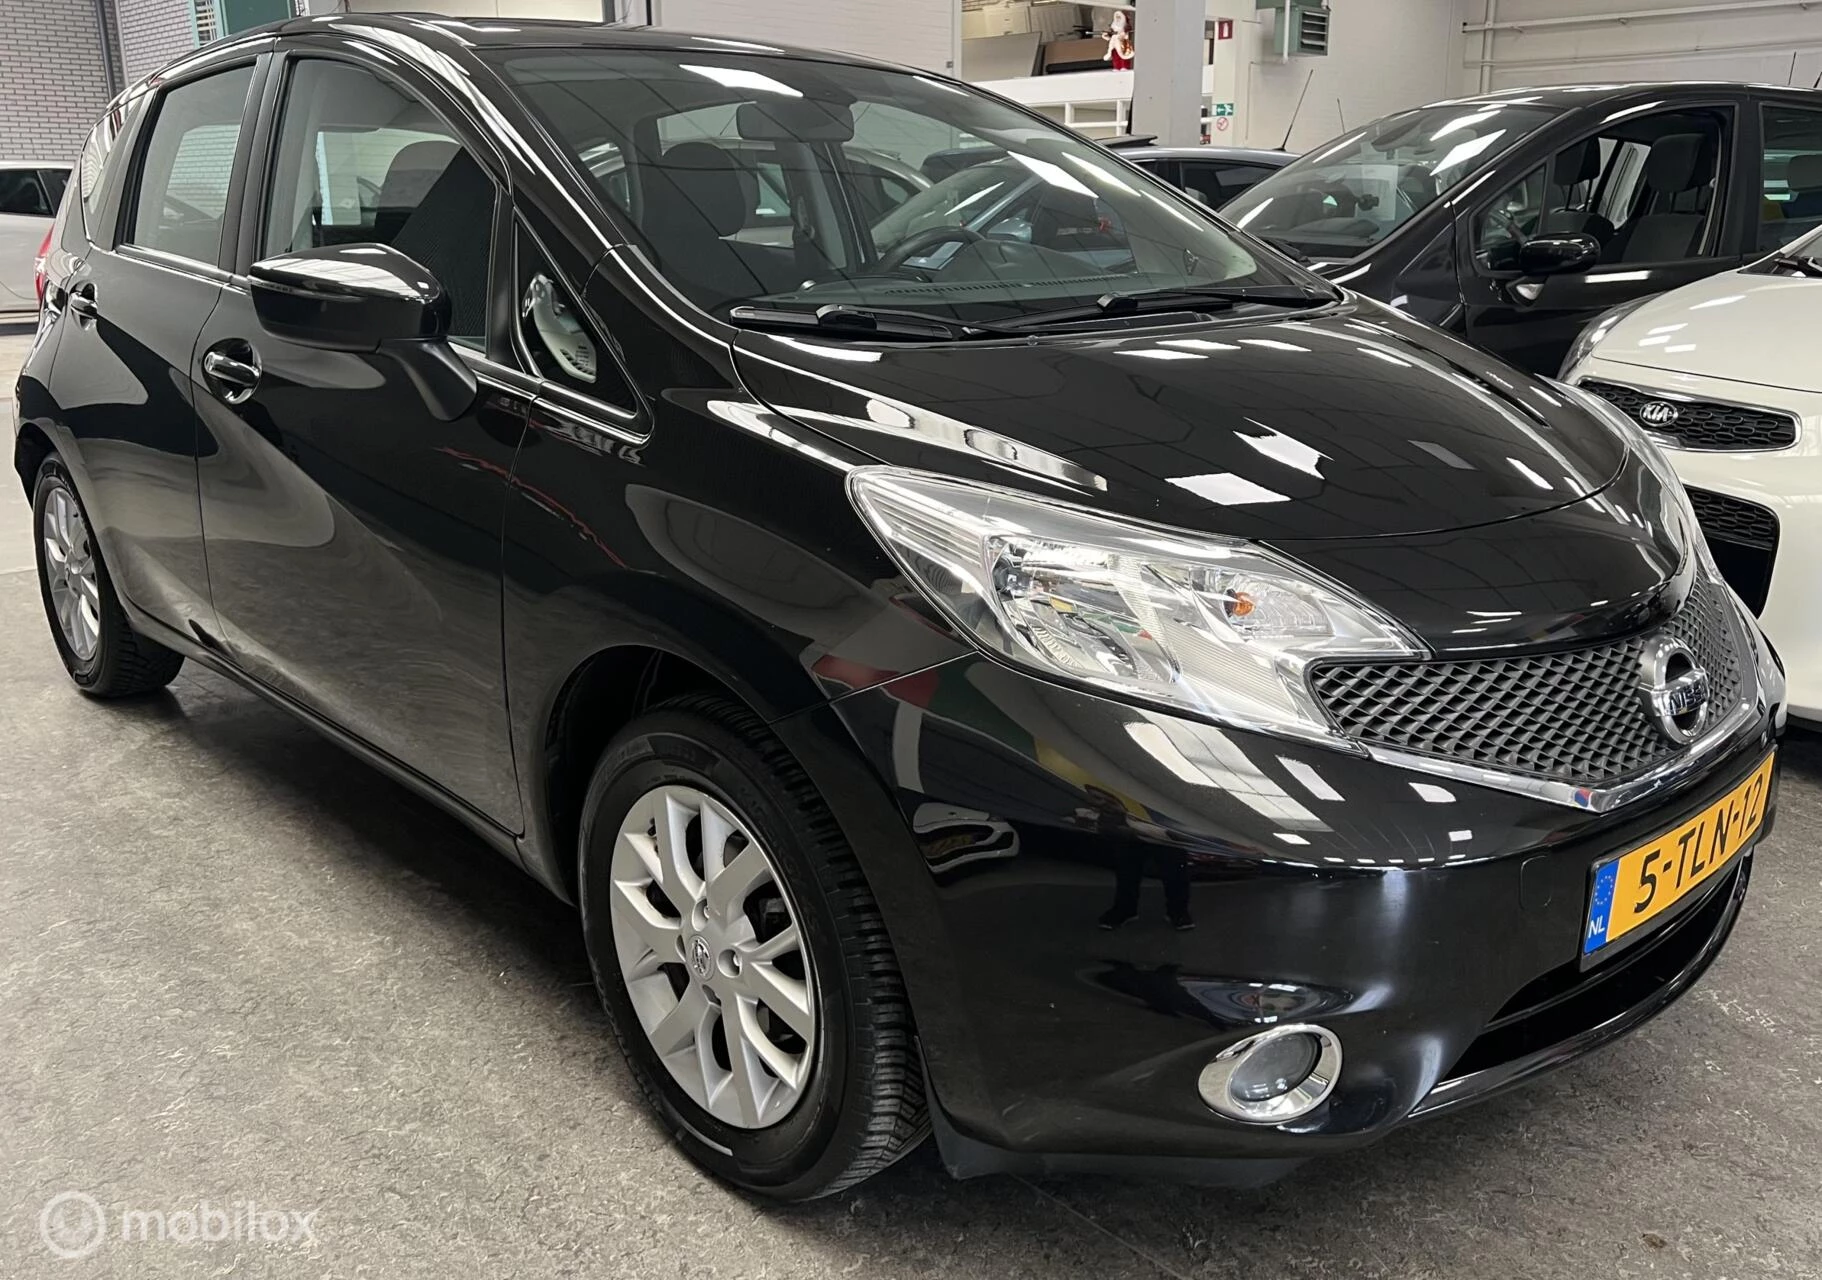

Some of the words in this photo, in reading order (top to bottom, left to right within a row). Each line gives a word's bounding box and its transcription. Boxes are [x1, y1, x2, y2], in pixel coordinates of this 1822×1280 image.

[1643, 404, 1669, 422] KIA
[1634, 771, 1763, 914] 5-TLN-12
[1588, 915, 1605, 938] NL
